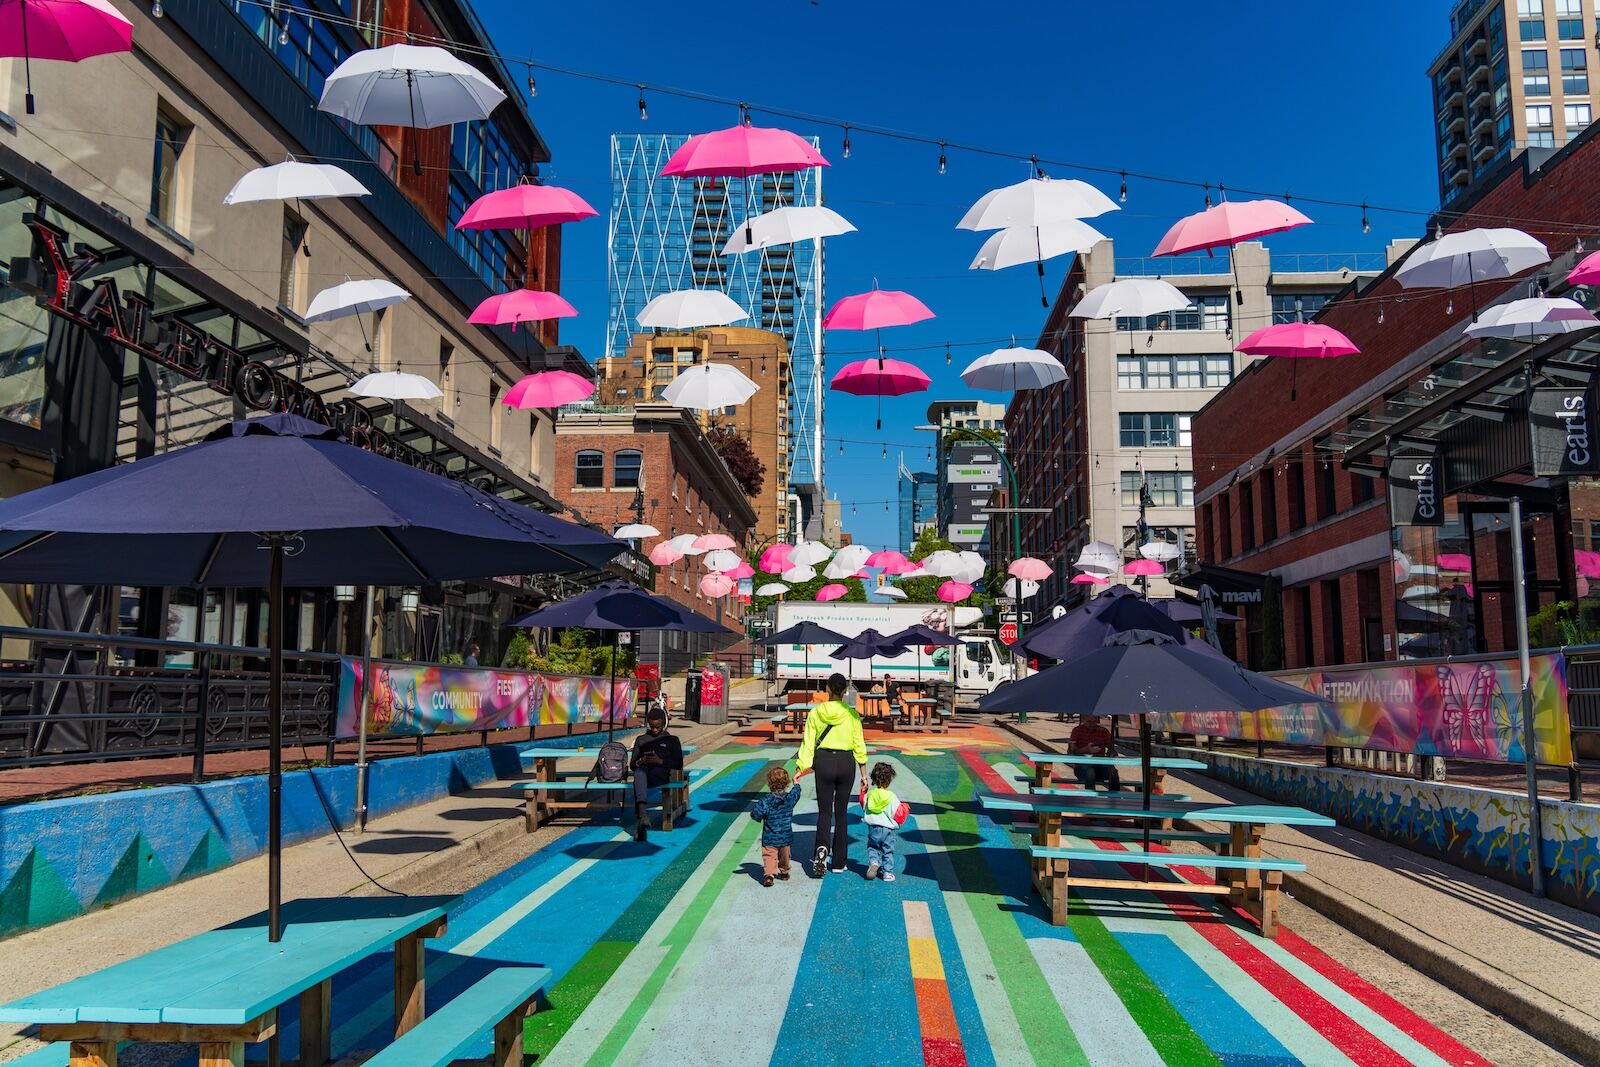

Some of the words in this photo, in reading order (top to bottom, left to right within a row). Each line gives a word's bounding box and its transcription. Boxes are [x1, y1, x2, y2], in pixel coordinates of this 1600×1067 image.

[1555, 395, 1590, 465] earls
[1409, 463, 1436, 518] earls
[1222, 588, 1262, 603] mavi
[496, 679, 521, 696] FIESTA
[1316, 679, 1414, 703] DETERMINATION
[432, 690, 483, 710] COMMUNITY
